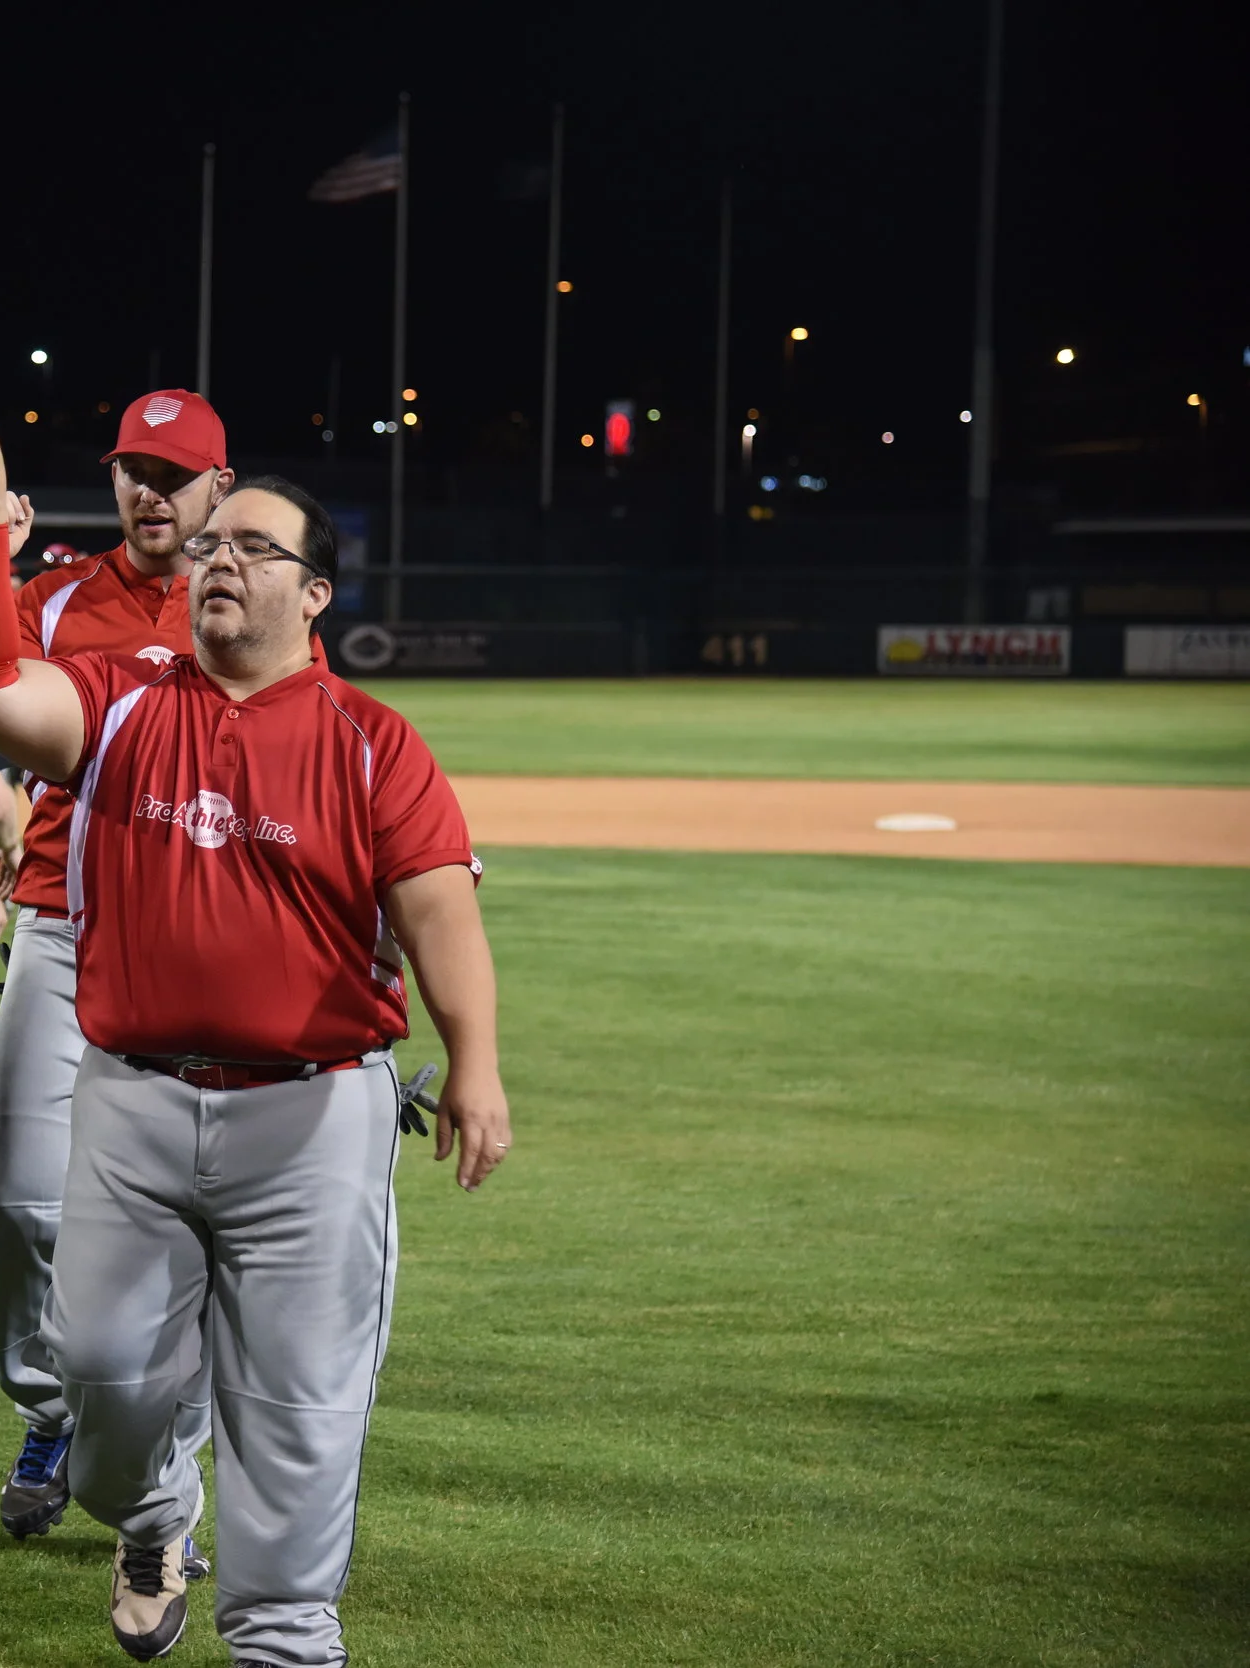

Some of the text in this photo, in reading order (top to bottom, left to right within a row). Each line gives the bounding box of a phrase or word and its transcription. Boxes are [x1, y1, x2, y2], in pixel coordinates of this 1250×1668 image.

[700, 633, 770, 668] 411
[926, 630, 1063, 655] LYNCH
[253, 815, 298, 846] Inc.
